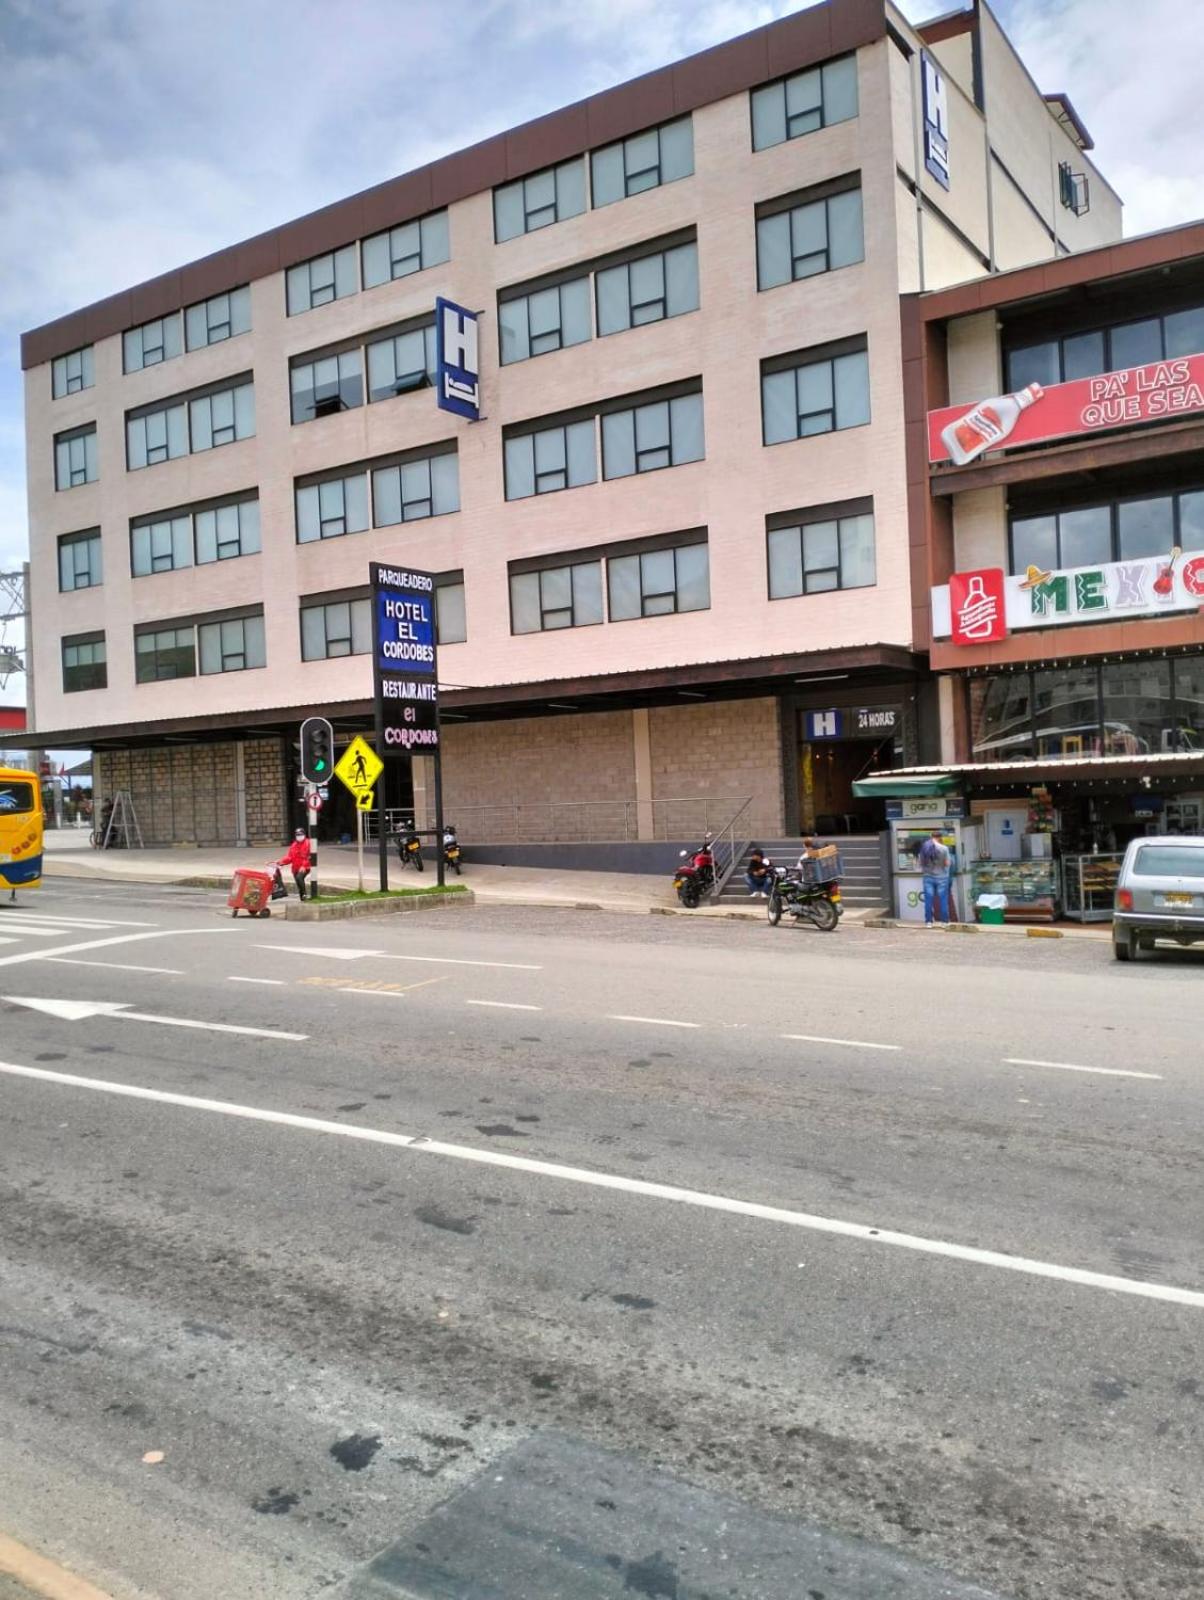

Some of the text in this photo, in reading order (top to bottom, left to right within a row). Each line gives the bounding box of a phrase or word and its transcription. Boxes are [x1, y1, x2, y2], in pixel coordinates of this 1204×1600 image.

[925, 60, 948, 141] H
[444, 307, 478, 375] H
[1136, 361, 1190, 391] LAS
[1080, 384, 1204, 426] QUE SEA
[378, 568, 432, 591] PARQUEADERO
[386, 599, 428, 622] HOTEL
[398, 622, 418, 640] EL
[383, 641, 434, 661] CORDOBES
[382, 680, 436, 700] RESTAURANTE
[813, 711, 836, 737] H
[858, 711, 895, 728] 24 HORAS
